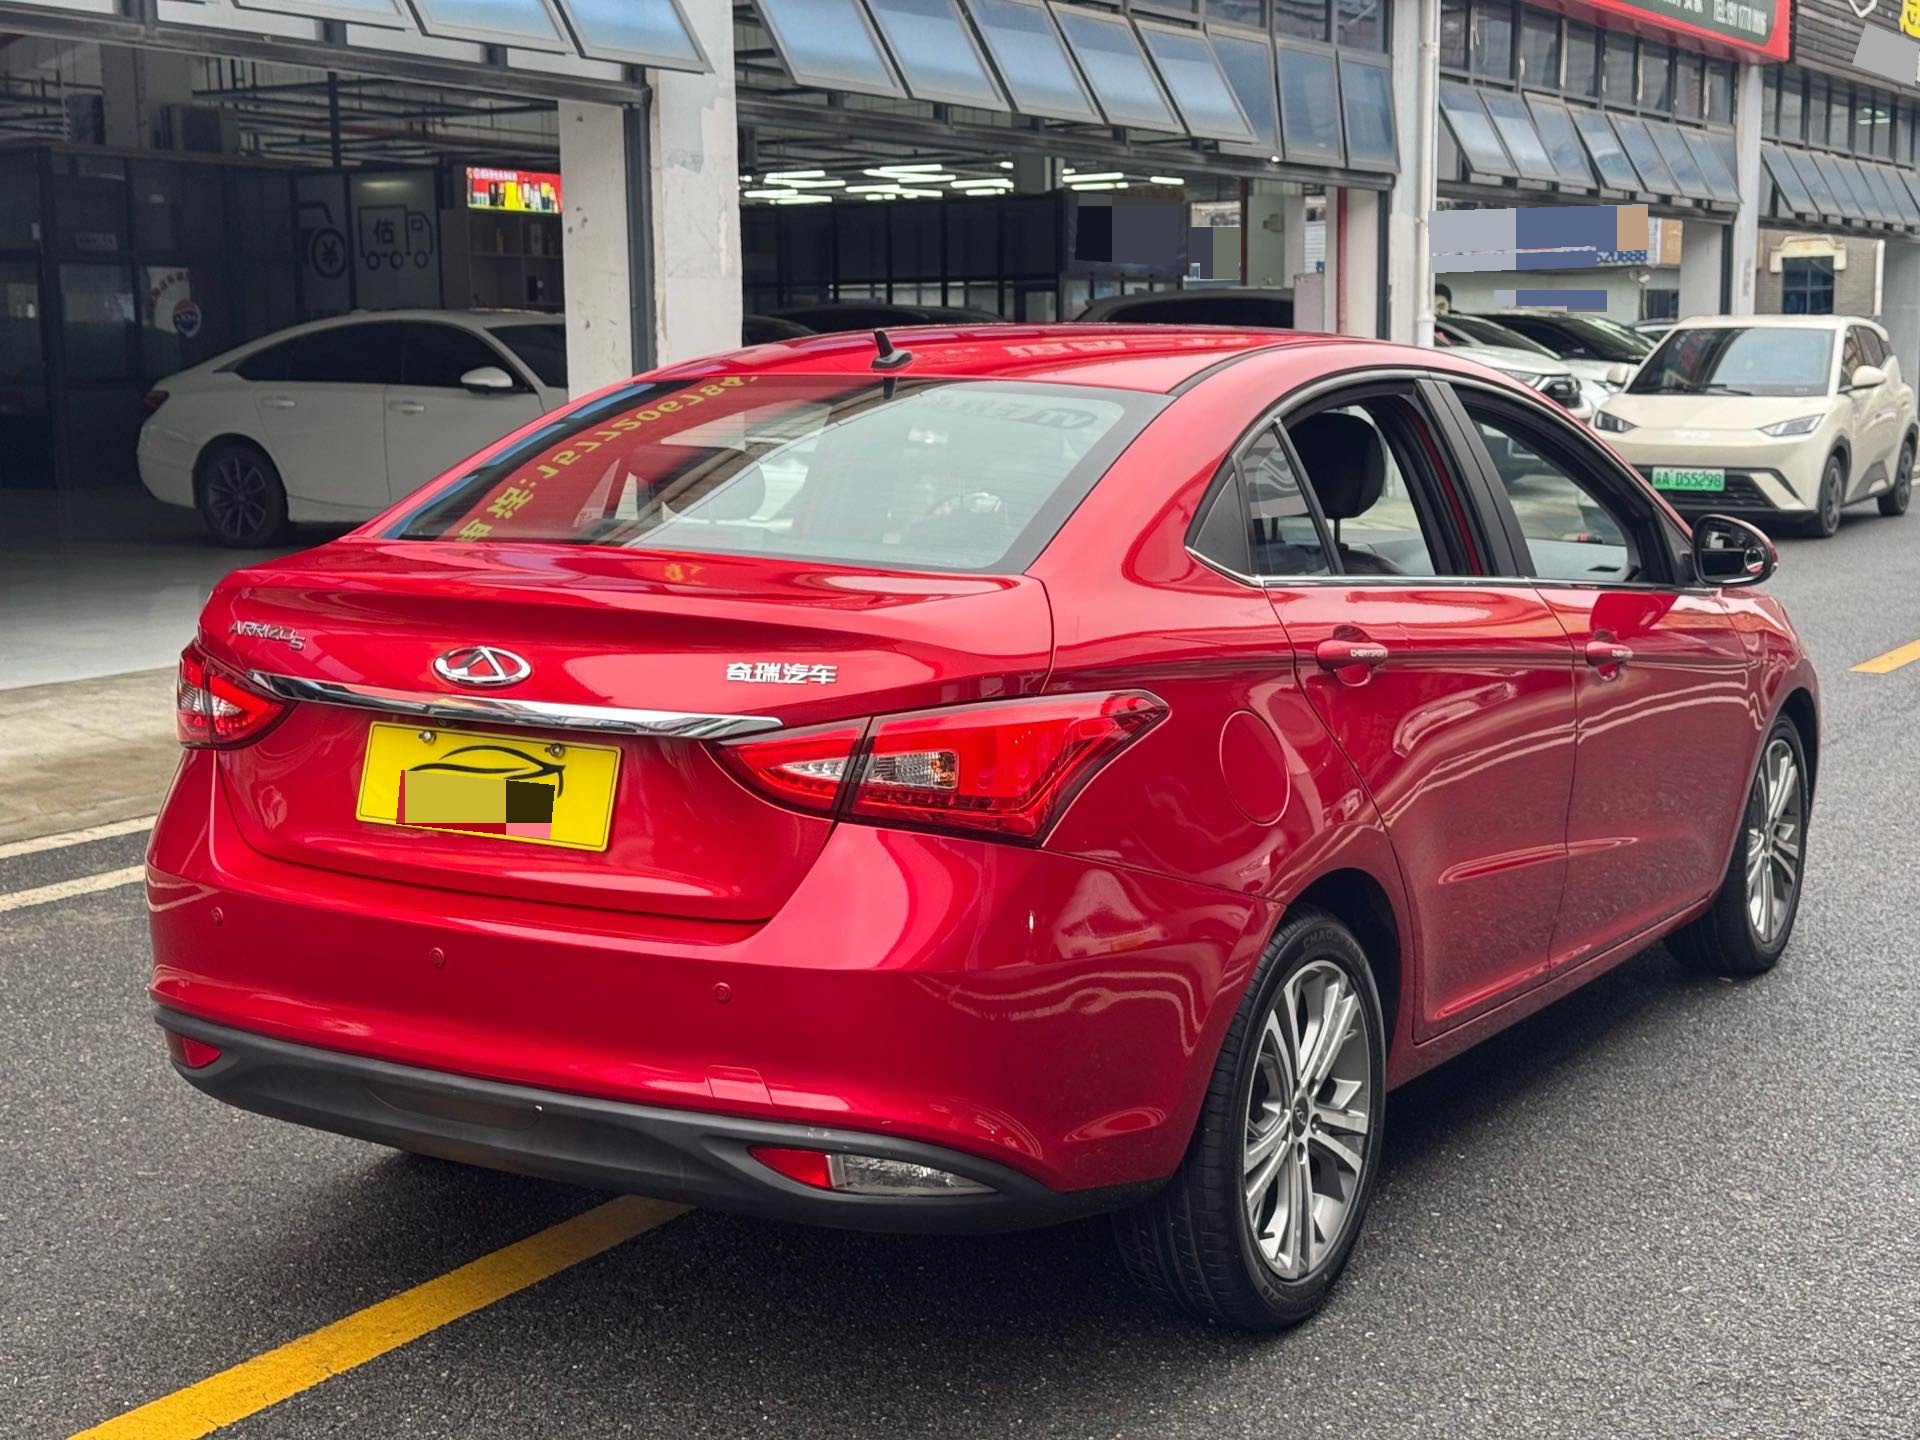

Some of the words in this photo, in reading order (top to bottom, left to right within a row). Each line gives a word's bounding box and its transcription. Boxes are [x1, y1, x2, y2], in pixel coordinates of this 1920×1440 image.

[374, 217, 395, 246] 估
[726, 661, 838, 685] 奇瑞汽车
